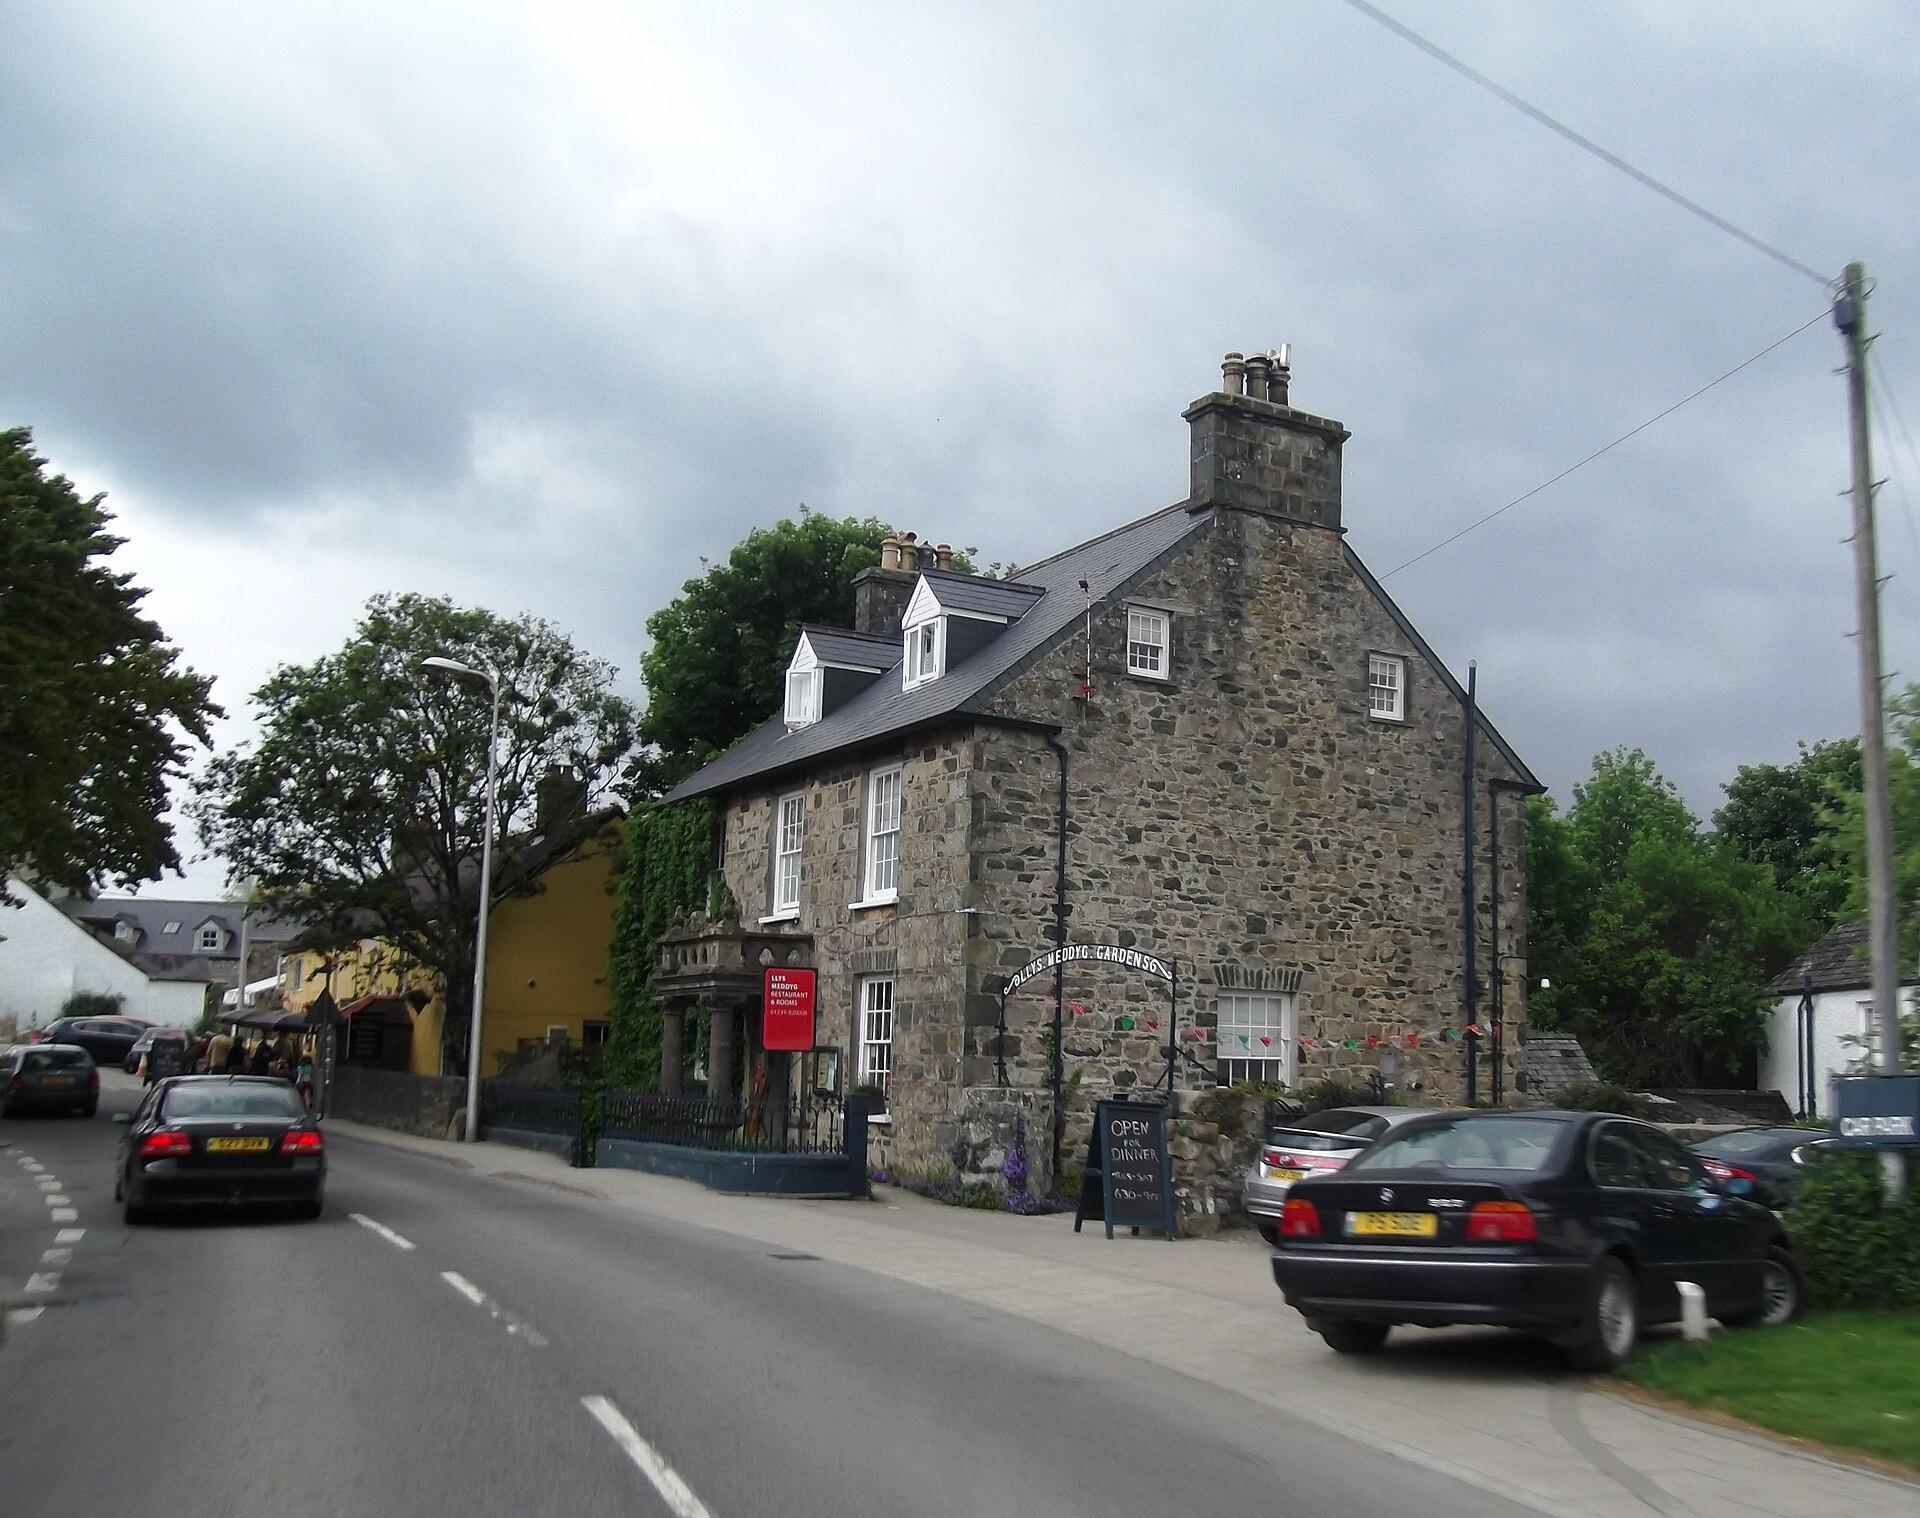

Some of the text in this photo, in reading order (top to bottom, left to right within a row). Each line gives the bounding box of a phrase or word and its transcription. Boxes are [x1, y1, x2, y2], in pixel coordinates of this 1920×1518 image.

[1097, 945, 1150, 971] GARDENS
[1111, 1120, 1149, 1137] OPEN
[1123, 1138, 1141, 1148] FOR
[1111, 1147, 1160, 1163] DINNER
